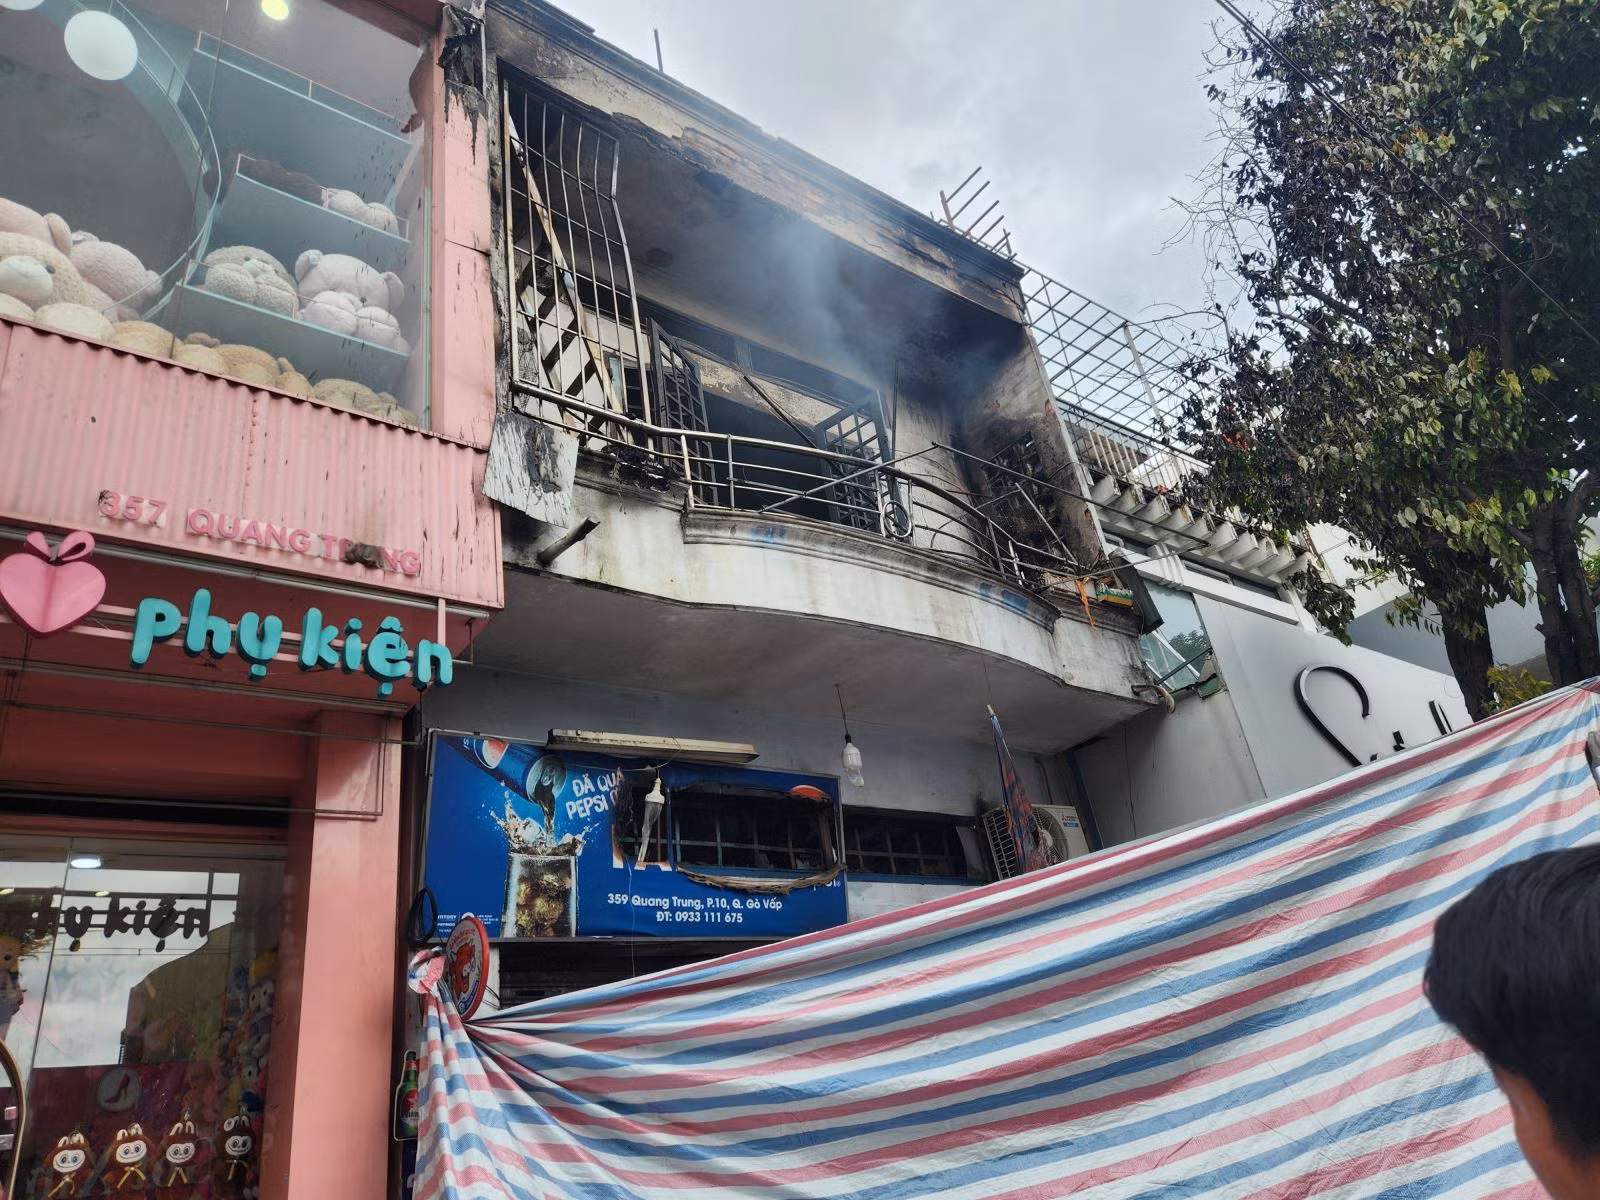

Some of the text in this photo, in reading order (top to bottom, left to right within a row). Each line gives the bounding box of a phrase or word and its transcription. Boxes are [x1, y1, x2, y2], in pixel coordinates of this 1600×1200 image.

[99, 490, 422, 577] 357 QUANG TRNG
[300, 607, 453, 697] kiện
[565, 794, 609, 820] PEPSI
[607, 893, 783, 912] 359 Quang Trung, P.10, Q. Gò Vấp
[675, 911, 701, 922] 0933
[704, 912, 721, 923] 111
[724, 912, 743, 924] 675
